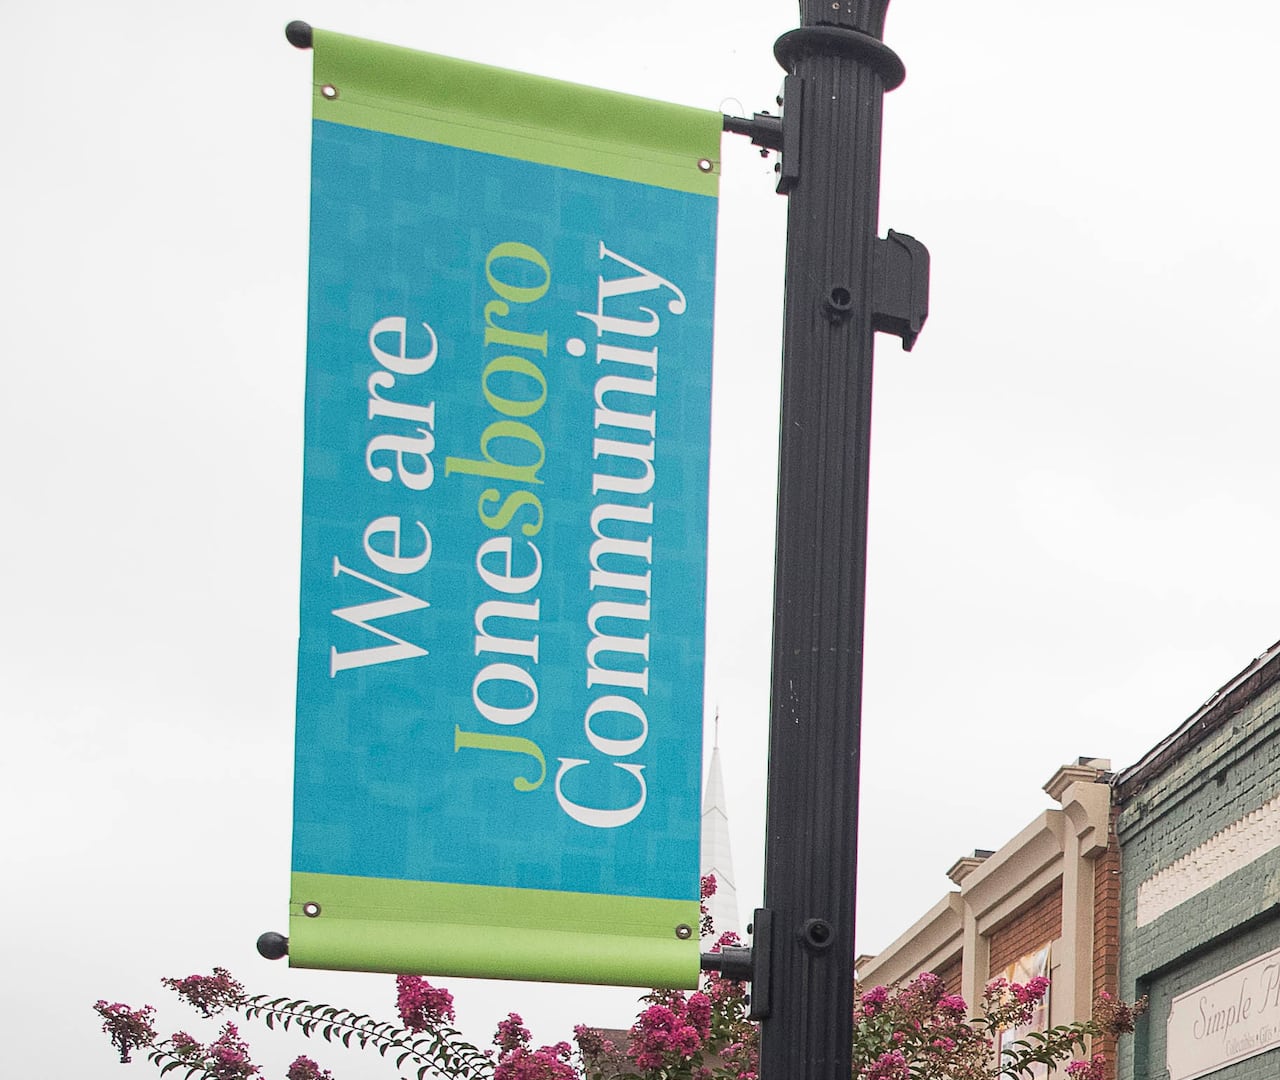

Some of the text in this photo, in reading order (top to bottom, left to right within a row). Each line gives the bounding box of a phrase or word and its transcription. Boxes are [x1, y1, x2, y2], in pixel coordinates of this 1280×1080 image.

[330, 315, 439, 678] We are
[444, 241, 552, 793] Jonesboro
[554, 239, 688, 829] Community
[1193, 977, 1251, 1042] Simple
